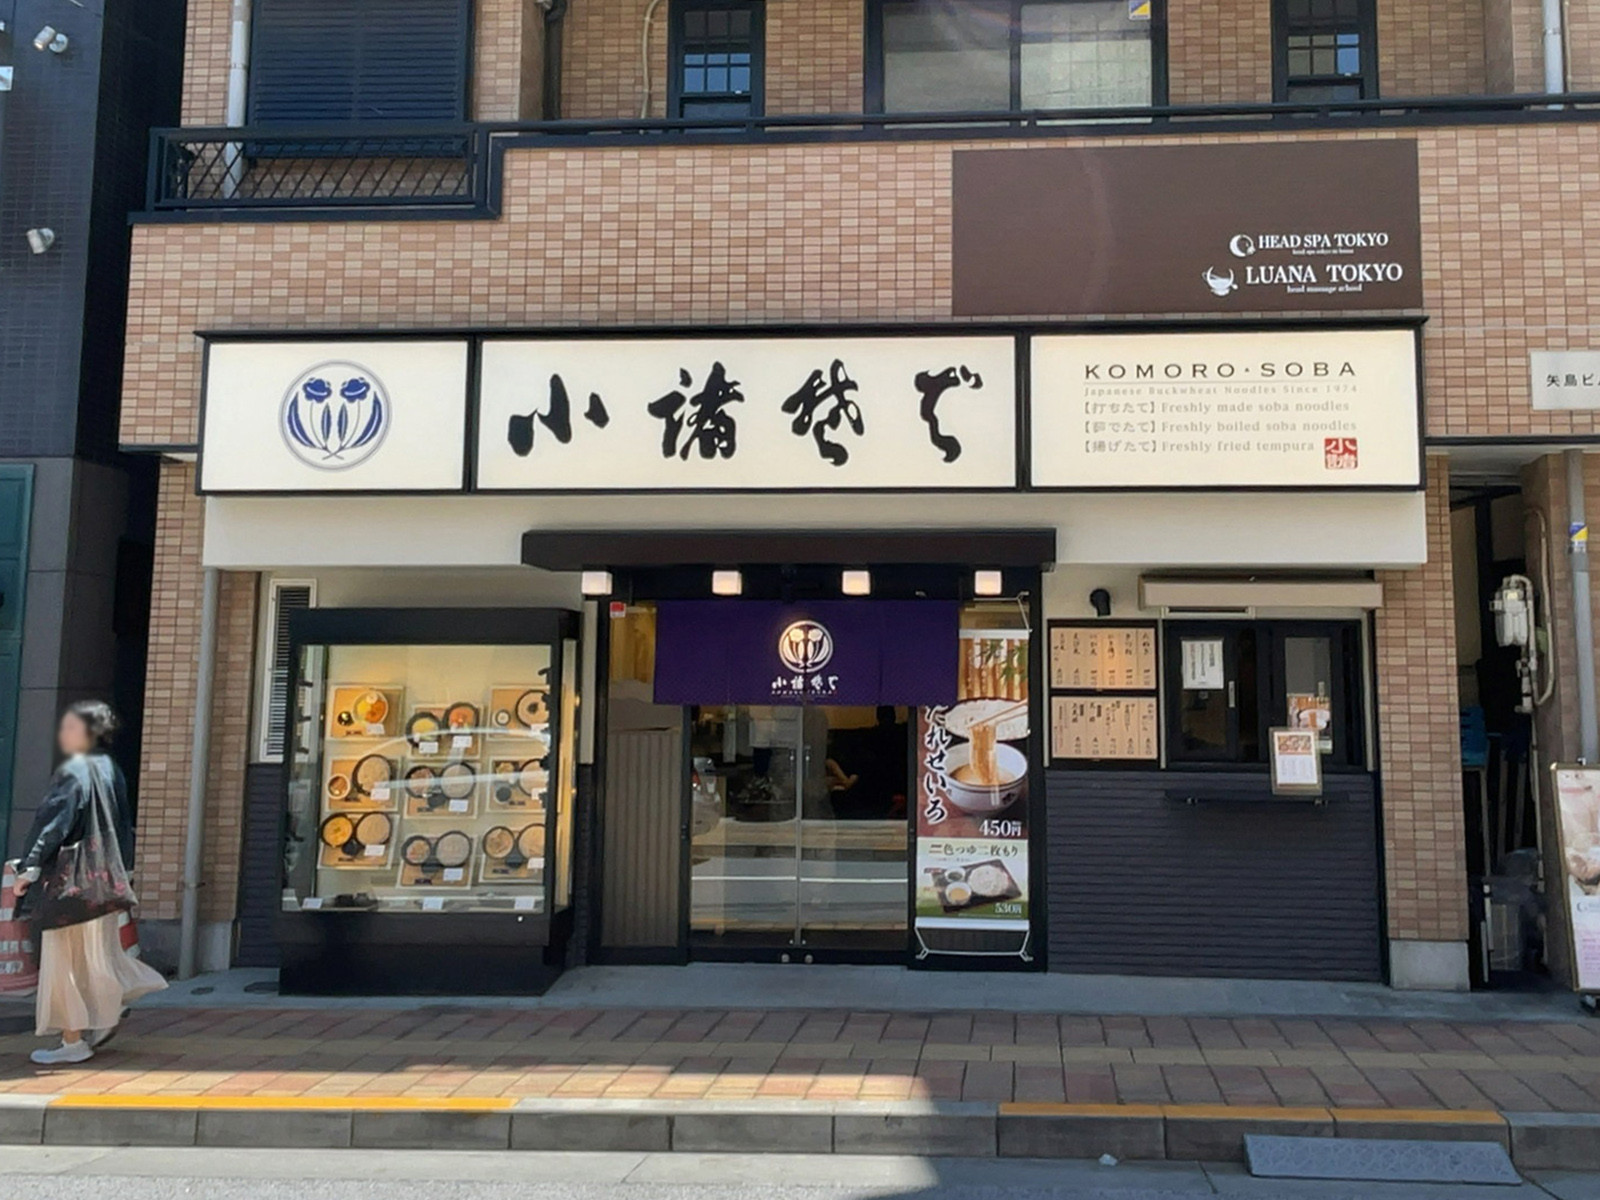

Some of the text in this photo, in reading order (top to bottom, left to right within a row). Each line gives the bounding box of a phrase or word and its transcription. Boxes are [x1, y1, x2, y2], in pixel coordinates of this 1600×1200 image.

[1258, 232, 1389, 249] HEAD SPA TOKYO
[1246, 263, 1403, 284] LUANA TOKYO
[1084, 384, 1357, 397] Japanese Buckwheat Noodles Since 1974
[1161, 402, 1210, 415] Freshly
[1217, 401, 1253, 412] made
[1258, 401, 1289, 412] soba
[1295, 401, 1349, 412] noodles
[1161, 421, 1211, 434] Freshly
[1217, 421, 1260, 432] boiled
[1266, 420, 1296, 431] soba
[1302, 420, 1356, 431] noodles
[1161, 441, 1211, 454] Freshly
[1217, 440, 1251, 452] fried
[1256, 441, 1314, 453] tempura
[979, 820, 1022, 837] 450円
